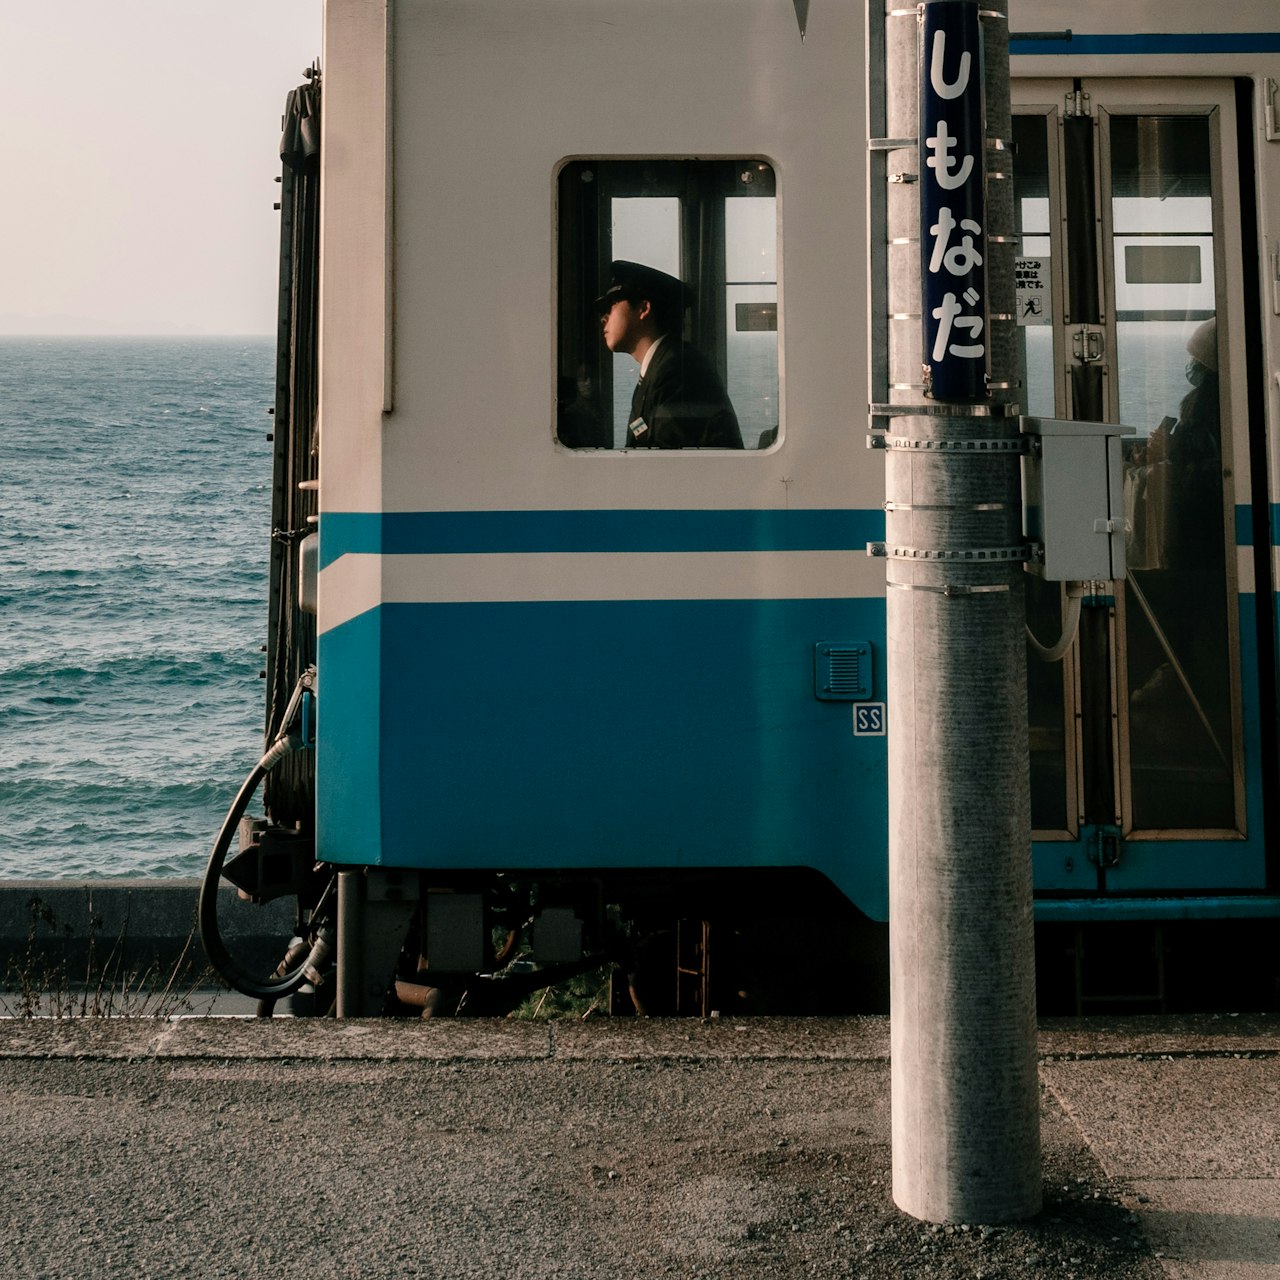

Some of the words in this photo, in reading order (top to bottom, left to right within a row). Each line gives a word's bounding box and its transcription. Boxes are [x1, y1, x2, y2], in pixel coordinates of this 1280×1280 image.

[926, 29, 985, 363] しもなだ
[858, 709, 880, 730] SS
